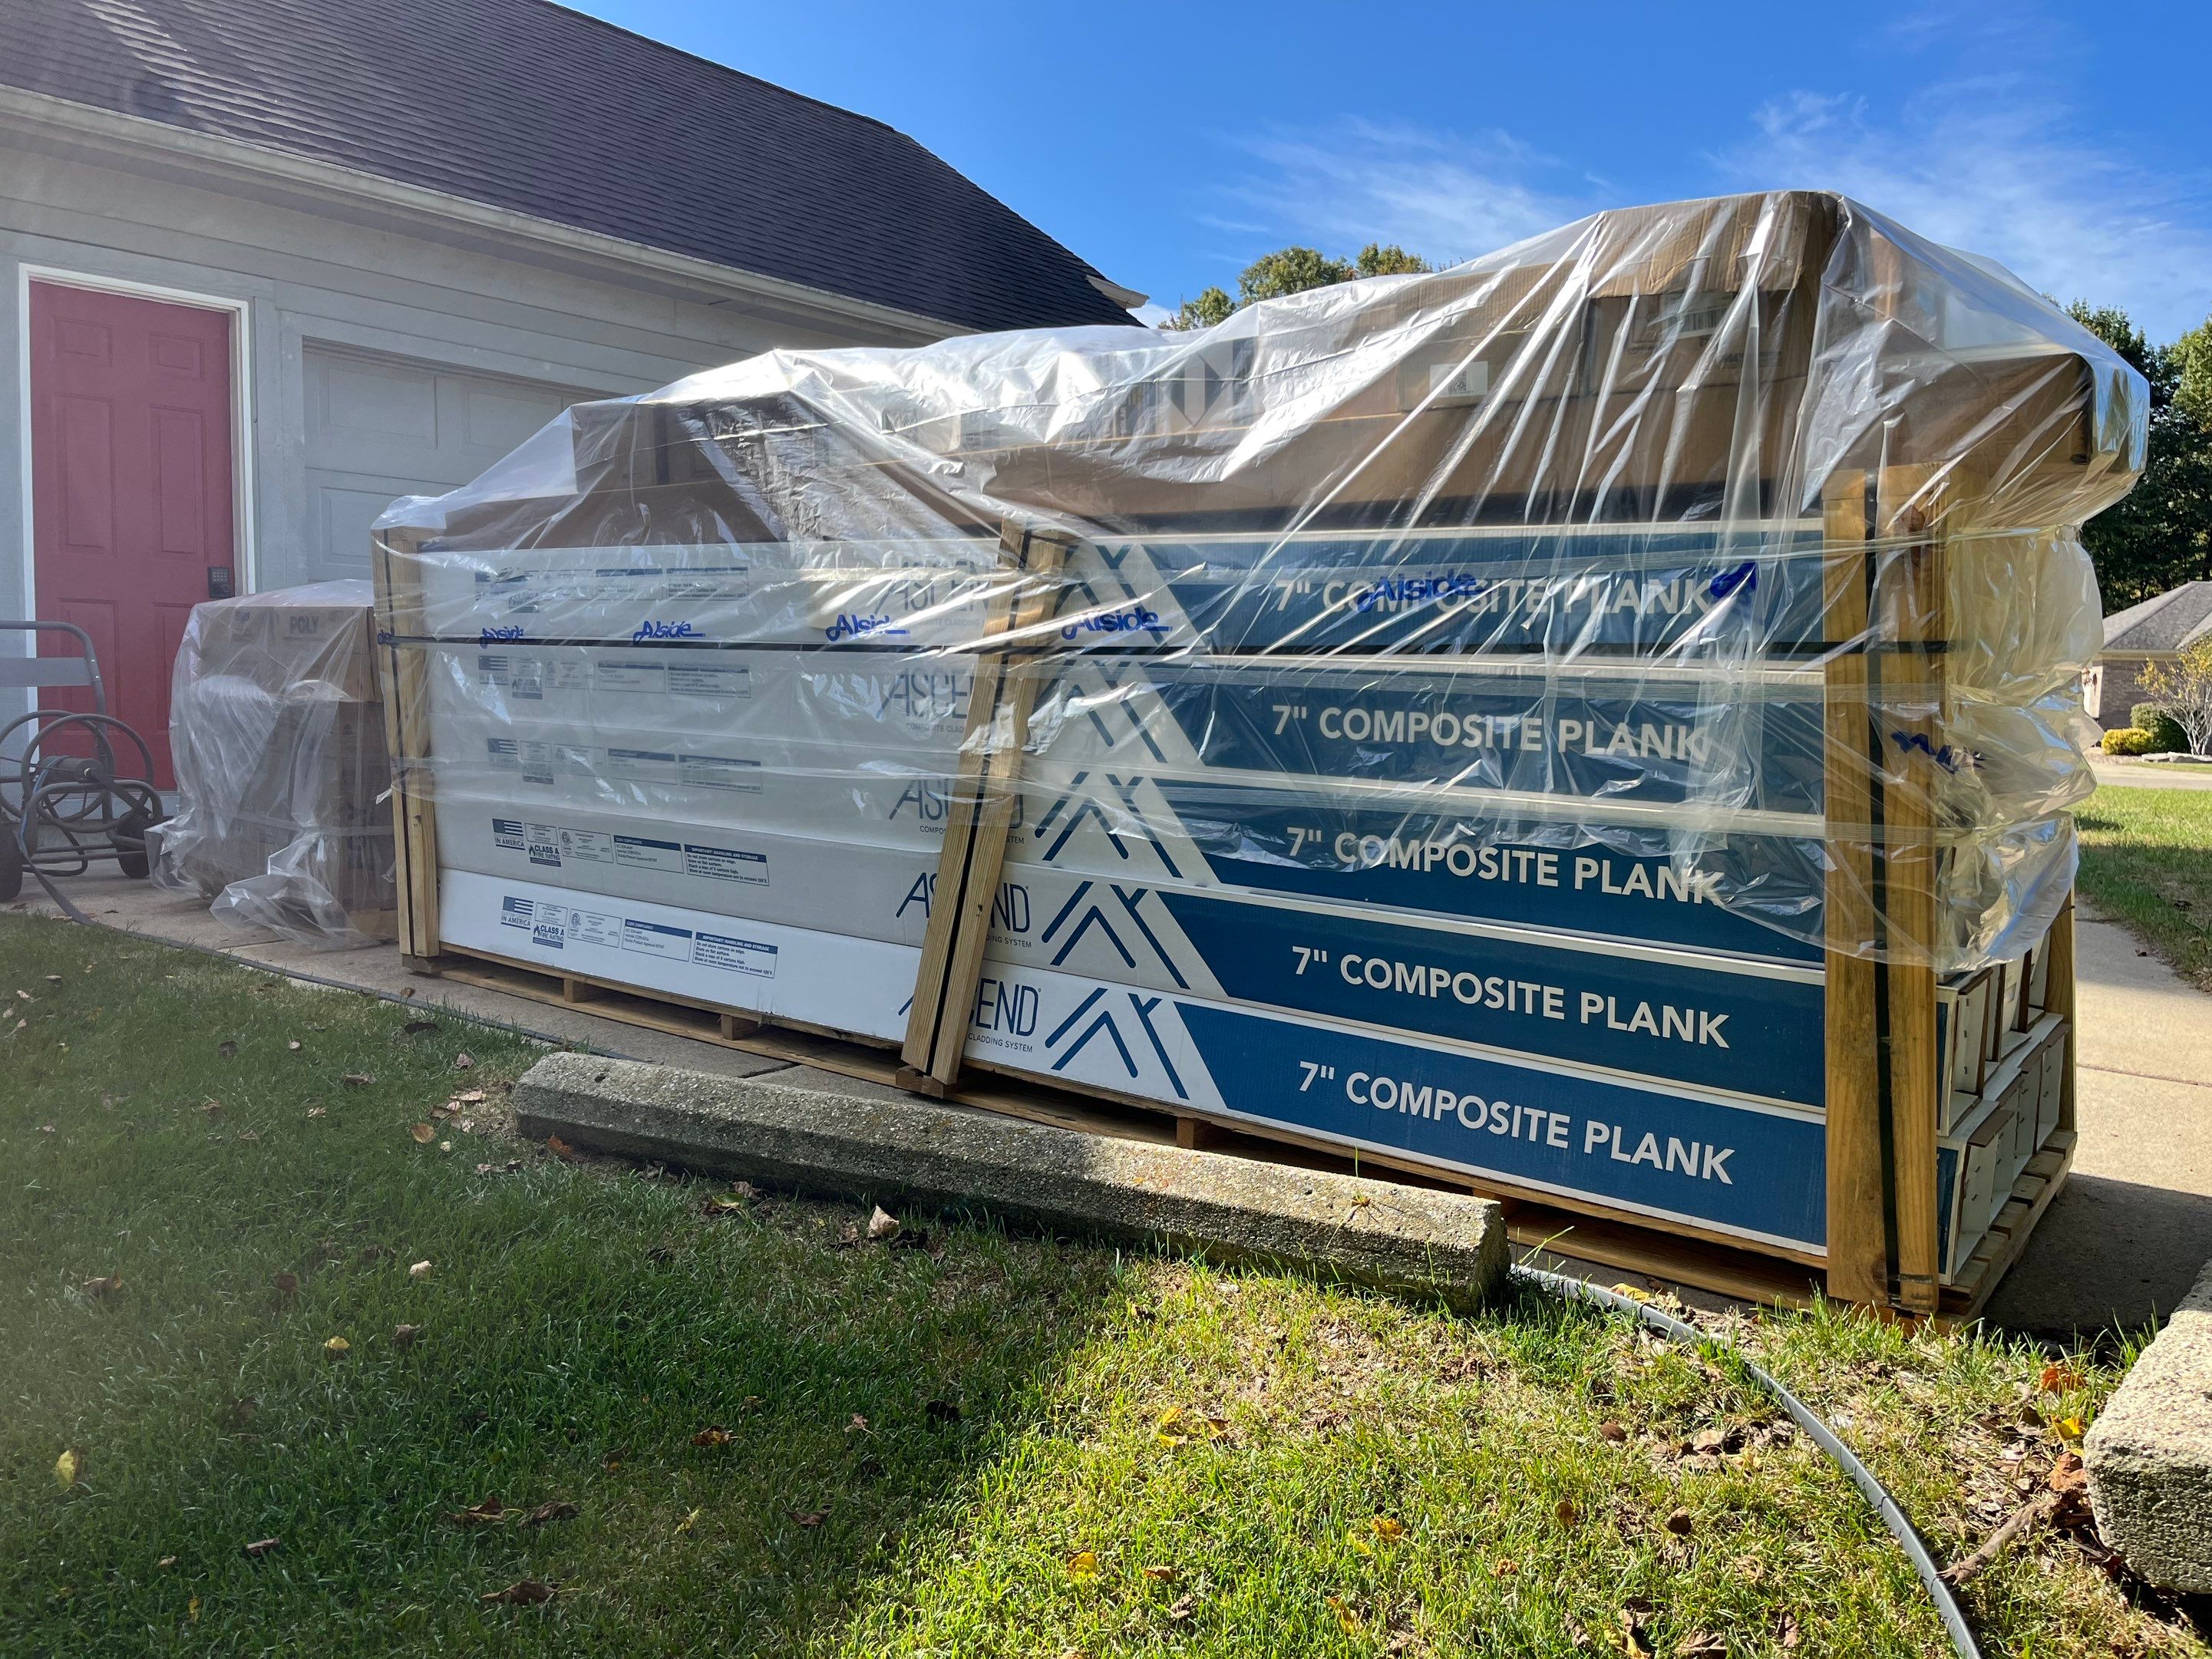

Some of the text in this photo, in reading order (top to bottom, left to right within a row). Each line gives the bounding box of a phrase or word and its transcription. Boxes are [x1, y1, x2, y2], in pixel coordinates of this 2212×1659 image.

[1323, 579, 1546, 614] COMPOSITE
[1563, 578, 1710, 615] PLANK
[633, 620, 705, 645] Alside
[1273, 704, 1711, 762] 7" COMPOSITE PLANK
[534, 845, 553, 854] CLASS
[1286, 827, 1727, 905] 7" COMPOSITE PLANK
[507, 917, 531, 926] AMERICA
[540, 925, 559, 935] CLASS
[1004, 937, 1032, 948] SYSTEM
[1292, 946, 1730, 1049] 7" COMPOSITE PLANK
[968, 1032, 1033, 1054] CLADDING SYSTEM
[1299, 1060, 1735, 1186] 7" COMPOSITE PLANK
